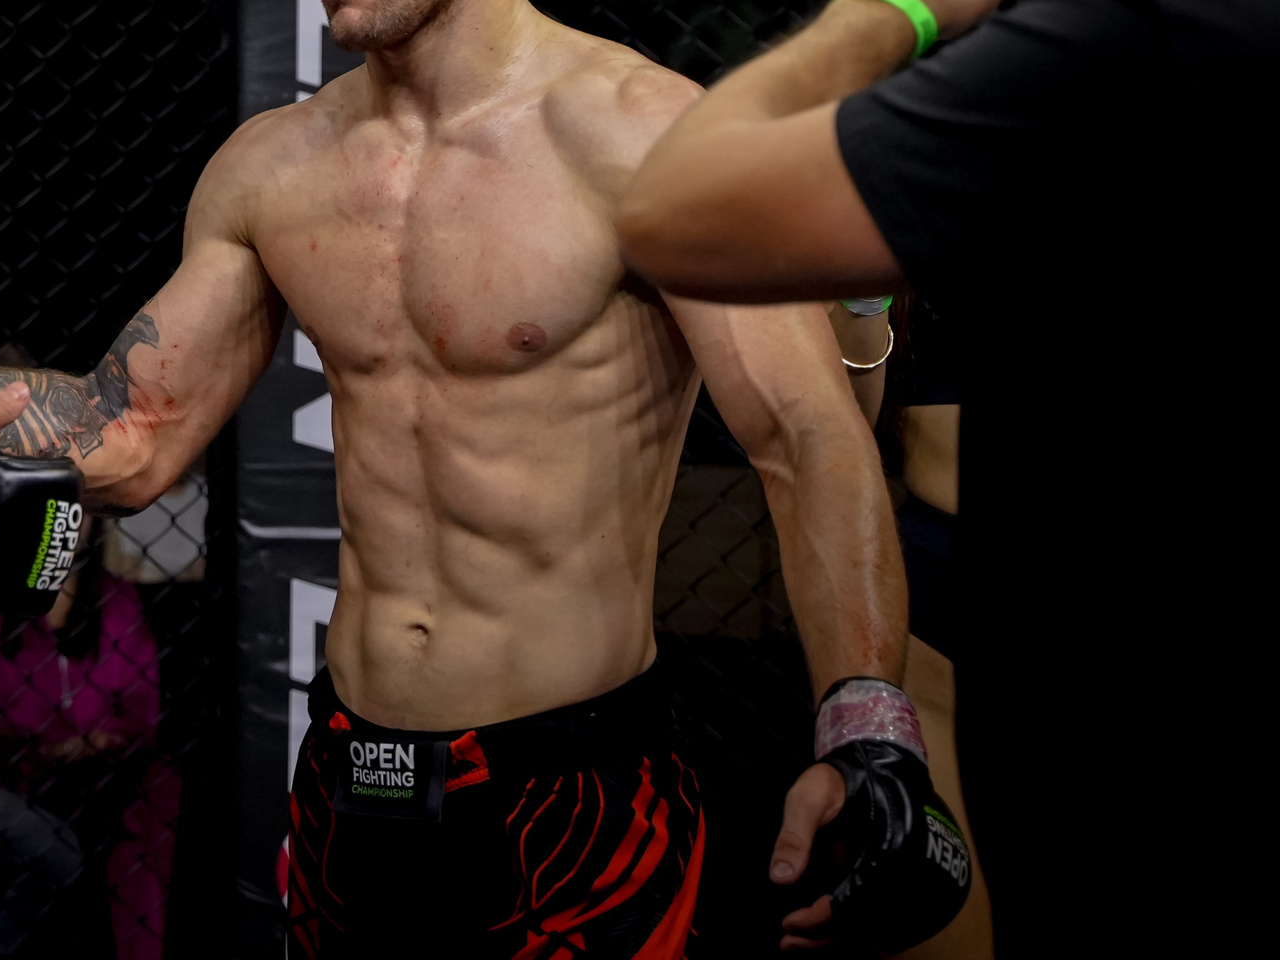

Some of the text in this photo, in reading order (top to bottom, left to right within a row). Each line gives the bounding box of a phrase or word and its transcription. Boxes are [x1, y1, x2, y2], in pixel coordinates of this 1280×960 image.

[26, 498, 57, 588] CHAMPIONSHIP
[36, 500, 69, 590] FIGHTING
[48, 502, 82, 591] OPEN
[349, 741, 415, 769] OPEN
[353, 767, 414, 787] FIGHTING
[351, 784, 414, 798] CHAMPIONSHIP
[926, 831, 968, 887] OPEN
